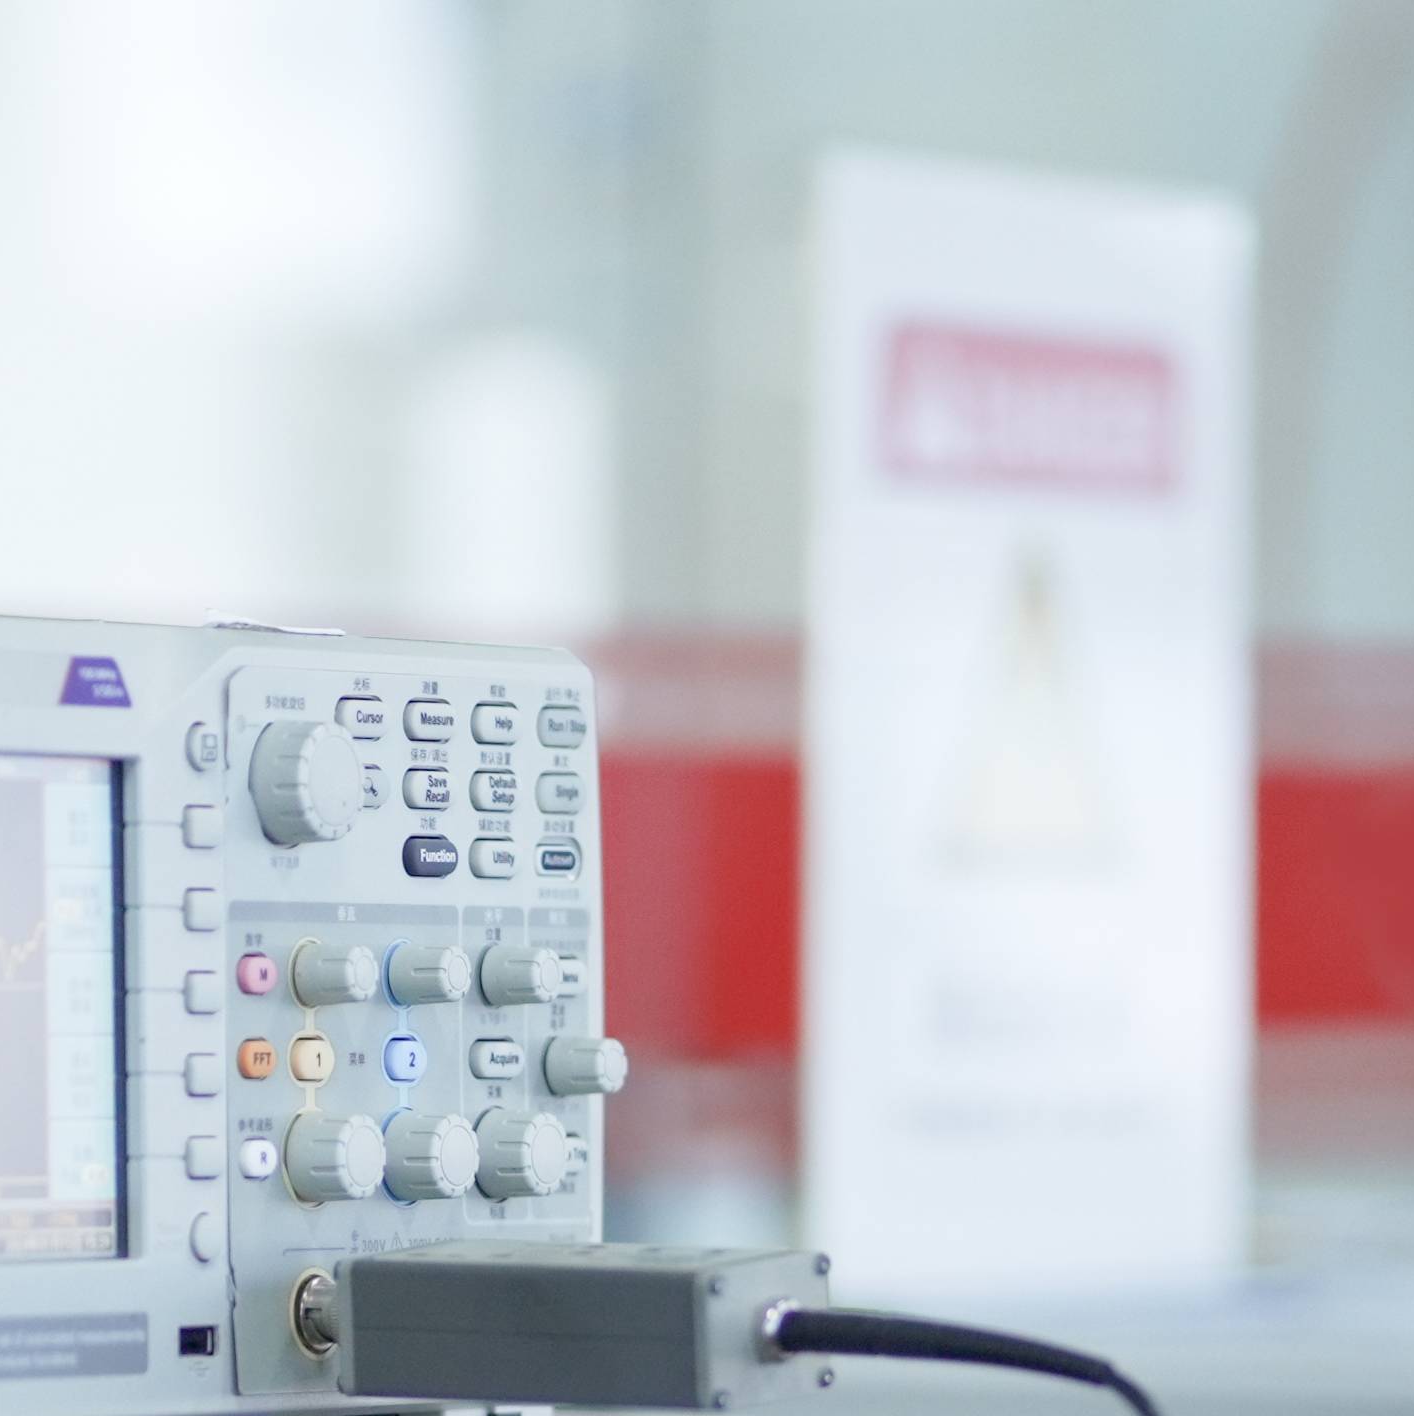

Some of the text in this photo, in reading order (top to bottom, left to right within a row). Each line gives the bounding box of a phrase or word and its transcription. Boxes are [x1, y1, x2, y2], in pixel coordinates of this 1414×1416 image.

[356, 710, 384, 724] Cursor
[420, 711, 454, 727] Measure
[495, 716, 513, 732] Help
[428, 775, 447, 788] Save
[489, 775, 517, 789] Default
[425, 789, 450, 803] Recall
[492, 790, 515, 806] Setup
[555, 784, 579, 801] Single
[420, 848, 456, 863] Function
[492, 850, 515, 867] Utility
[259, 968, 268, 981] M
[253, 1052, 271, 1066] FFT
[315, 1052, 322, 1068] 1
[408, 1051, 416, 1068] 2
[489, 1052, 519, 1068] Acquire
[260, 1151, 267, 1164] R
